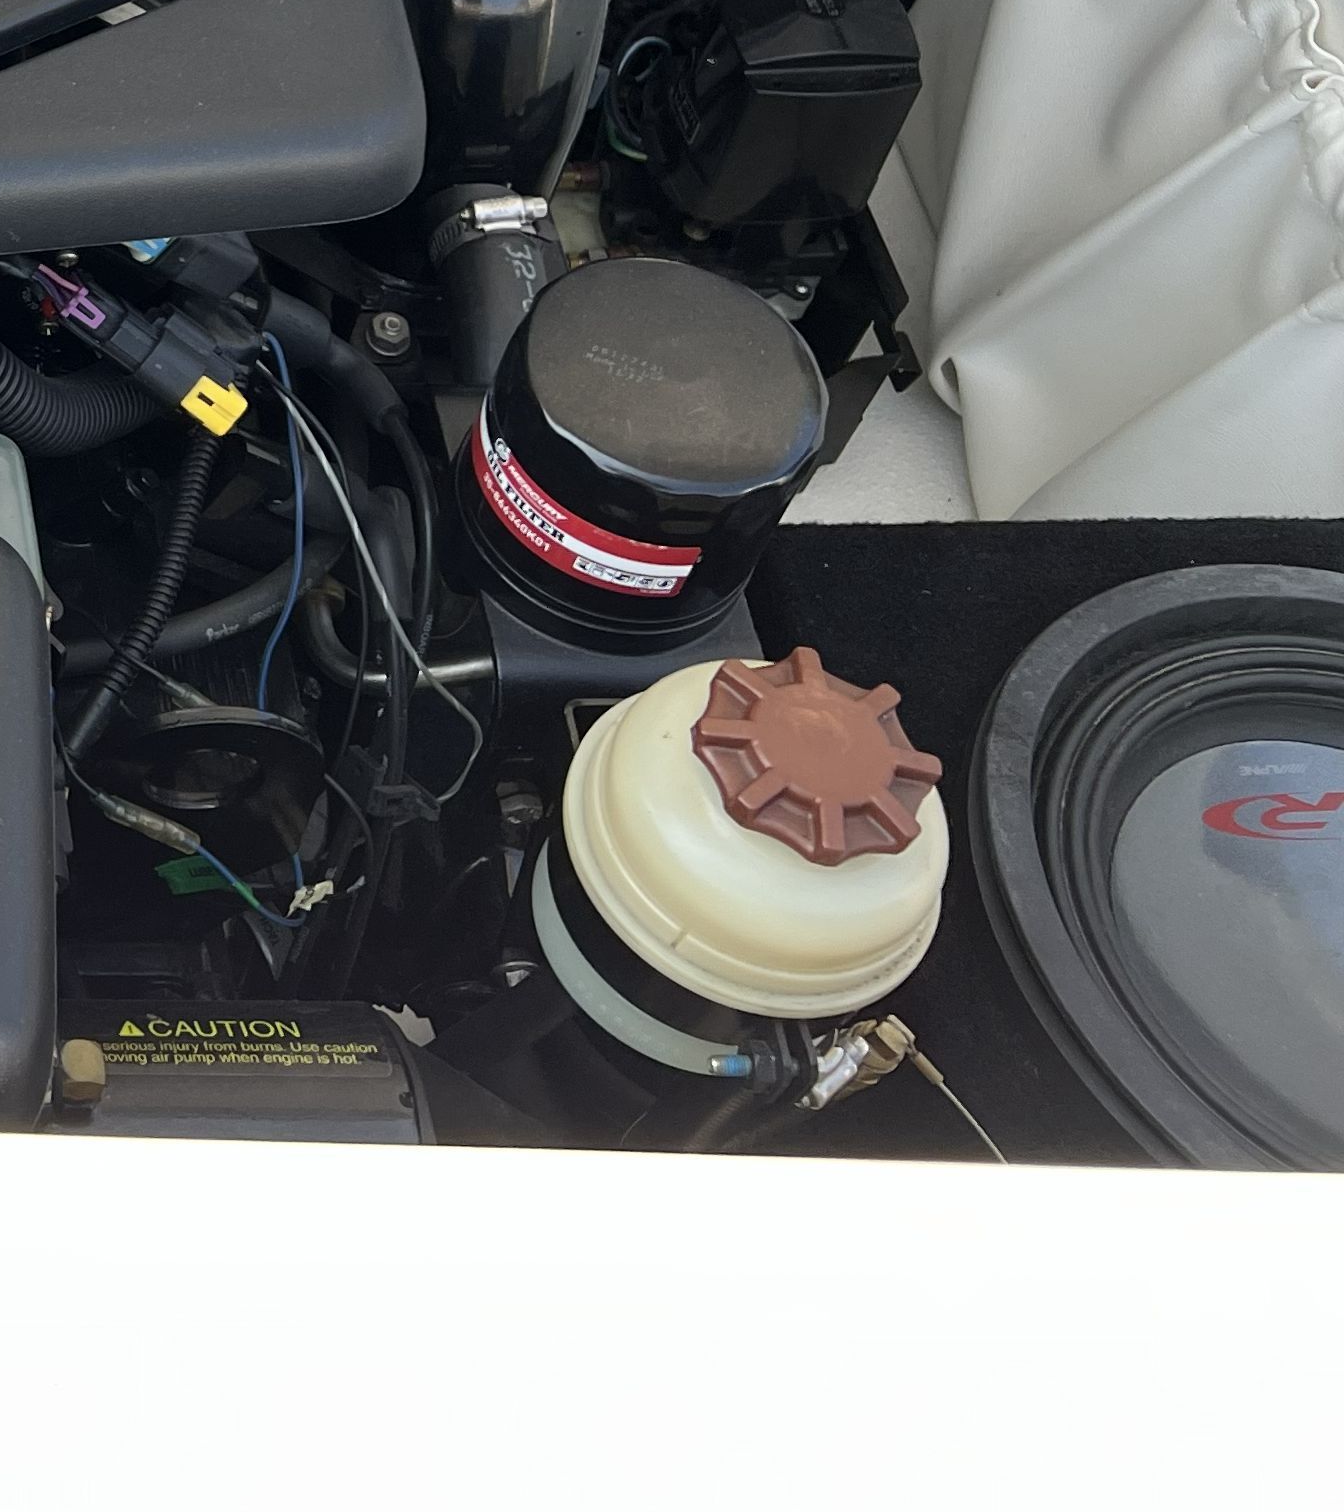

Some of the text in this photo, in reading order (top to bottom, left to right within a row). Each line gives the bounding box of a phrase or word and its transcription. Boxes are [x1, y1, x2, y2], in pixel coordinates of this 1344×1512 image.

[488, 450, 505, 484] OIL
[505, 483, 565, 544] FILTER
[508, 464, 567, 522] MERCURY
[148, 1020, 301, 1038] CAUTION
[102, 1040, 378, 1054] serious injury from burns. Use caution
[151, 1053, 170, 1064] air
[174, 1054, 215, 1066] pump
[219, 1053, 260, 1064] when
[264, 1054, 313, 1066] engine
[317, 1053, 330, 1064] is
[333, 1054, 361, 1065] hot.
